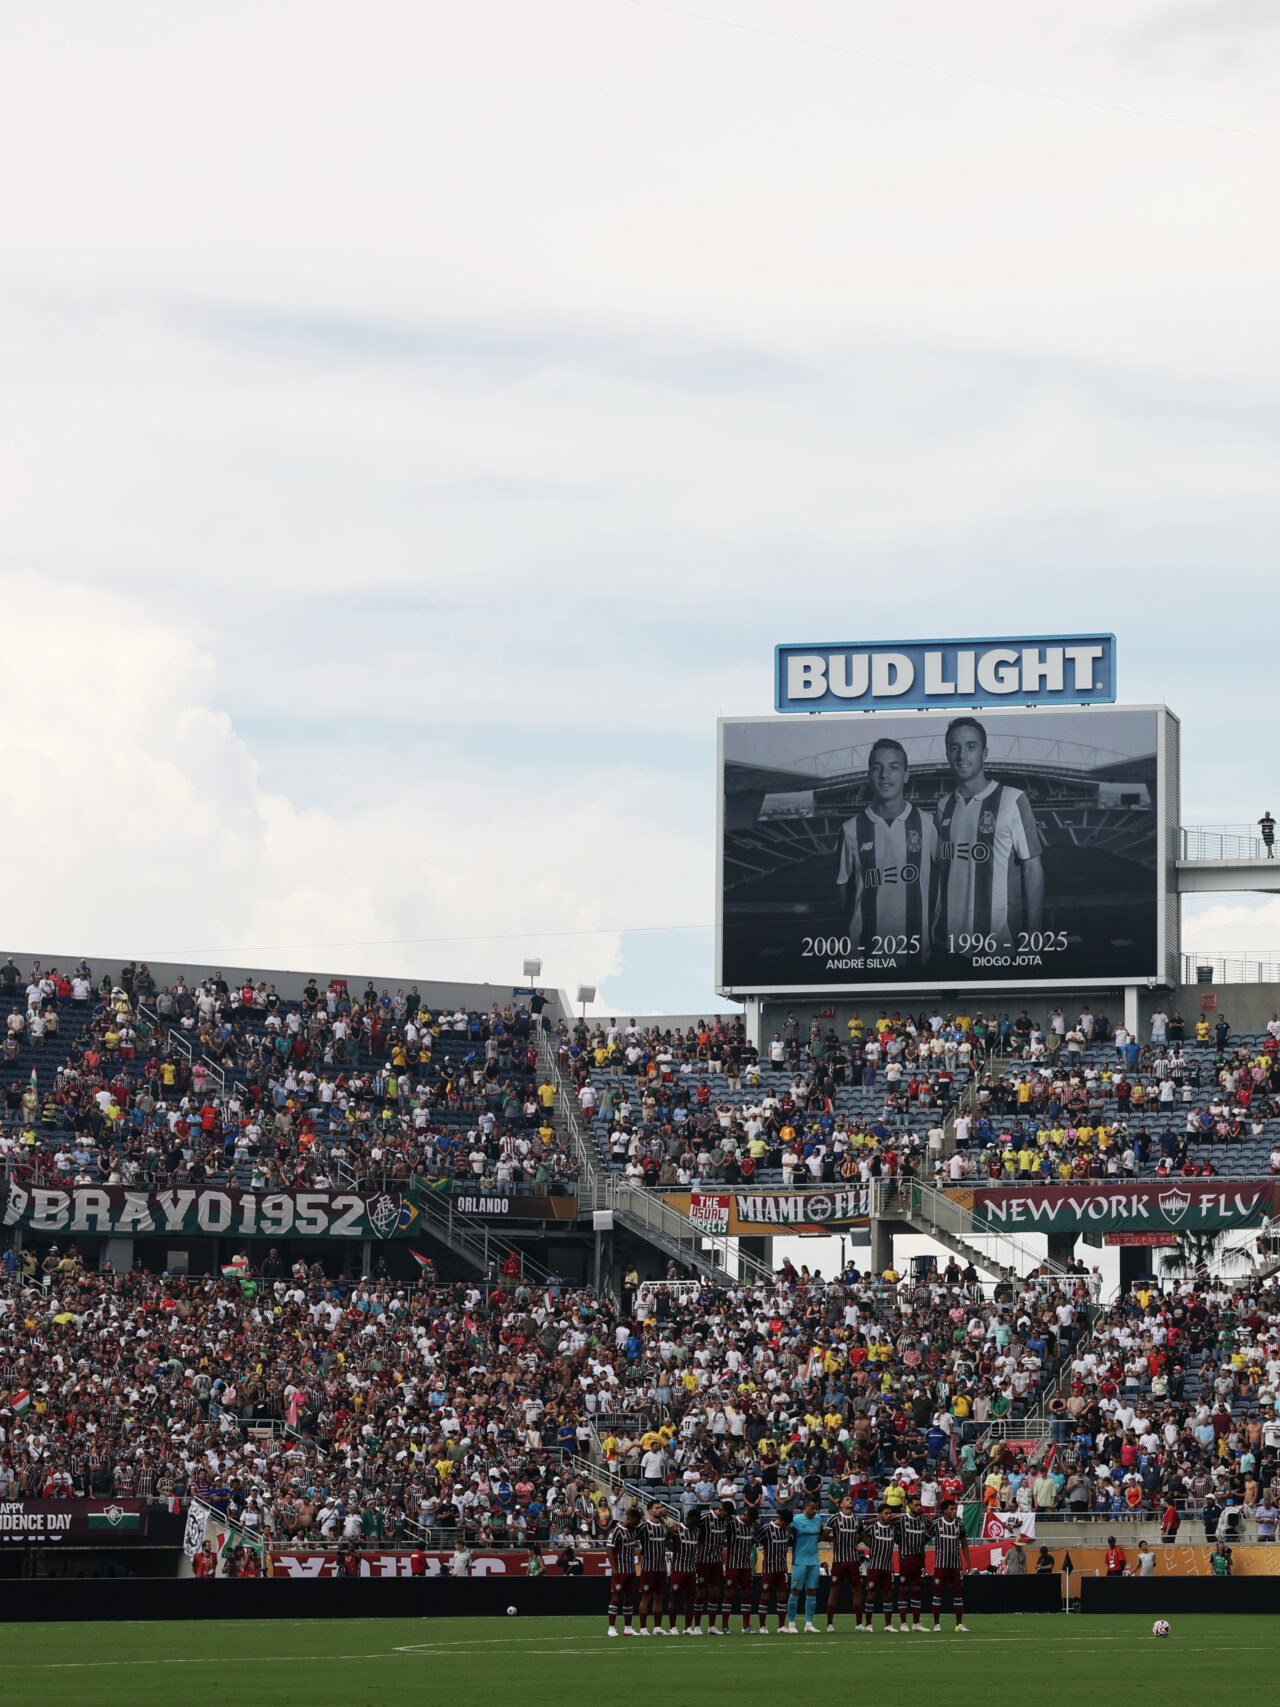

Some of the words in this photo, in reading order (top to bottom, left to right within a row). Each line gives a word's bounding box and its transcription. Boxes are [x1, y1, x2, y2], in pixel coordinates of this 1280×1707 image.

[787, 653, 914, 699] BUD
[924, 646, 1102, 695] LIGHT
[801, 936, 851, 956] 2000
[871, 934, 921, 954] 2025
[947, 932, 997, 953] 1996
[1017, 931, 1068, 952] 2025
[826, 956, 865, 969] ANDRÉ
[866, 958, 897, 968] SILVA
[972, 956, 1011, 967] DIOGO
[1012, 955, 1042, 966] JOTA
[457, 1196, 509, 1214] ORLANDO
[699, 1196, 720, 1209] THE
[736, 1195, 805, 1223] MIAMI
[984, 1198, 1062, 1222] NEW
[1068, 1194, 1150, 1220] YORK
[692, 1204, 724, 1220] USUAL
[0, 1502, 24, 1514] APPY
[47, 1514, 72, 1530] DAY
